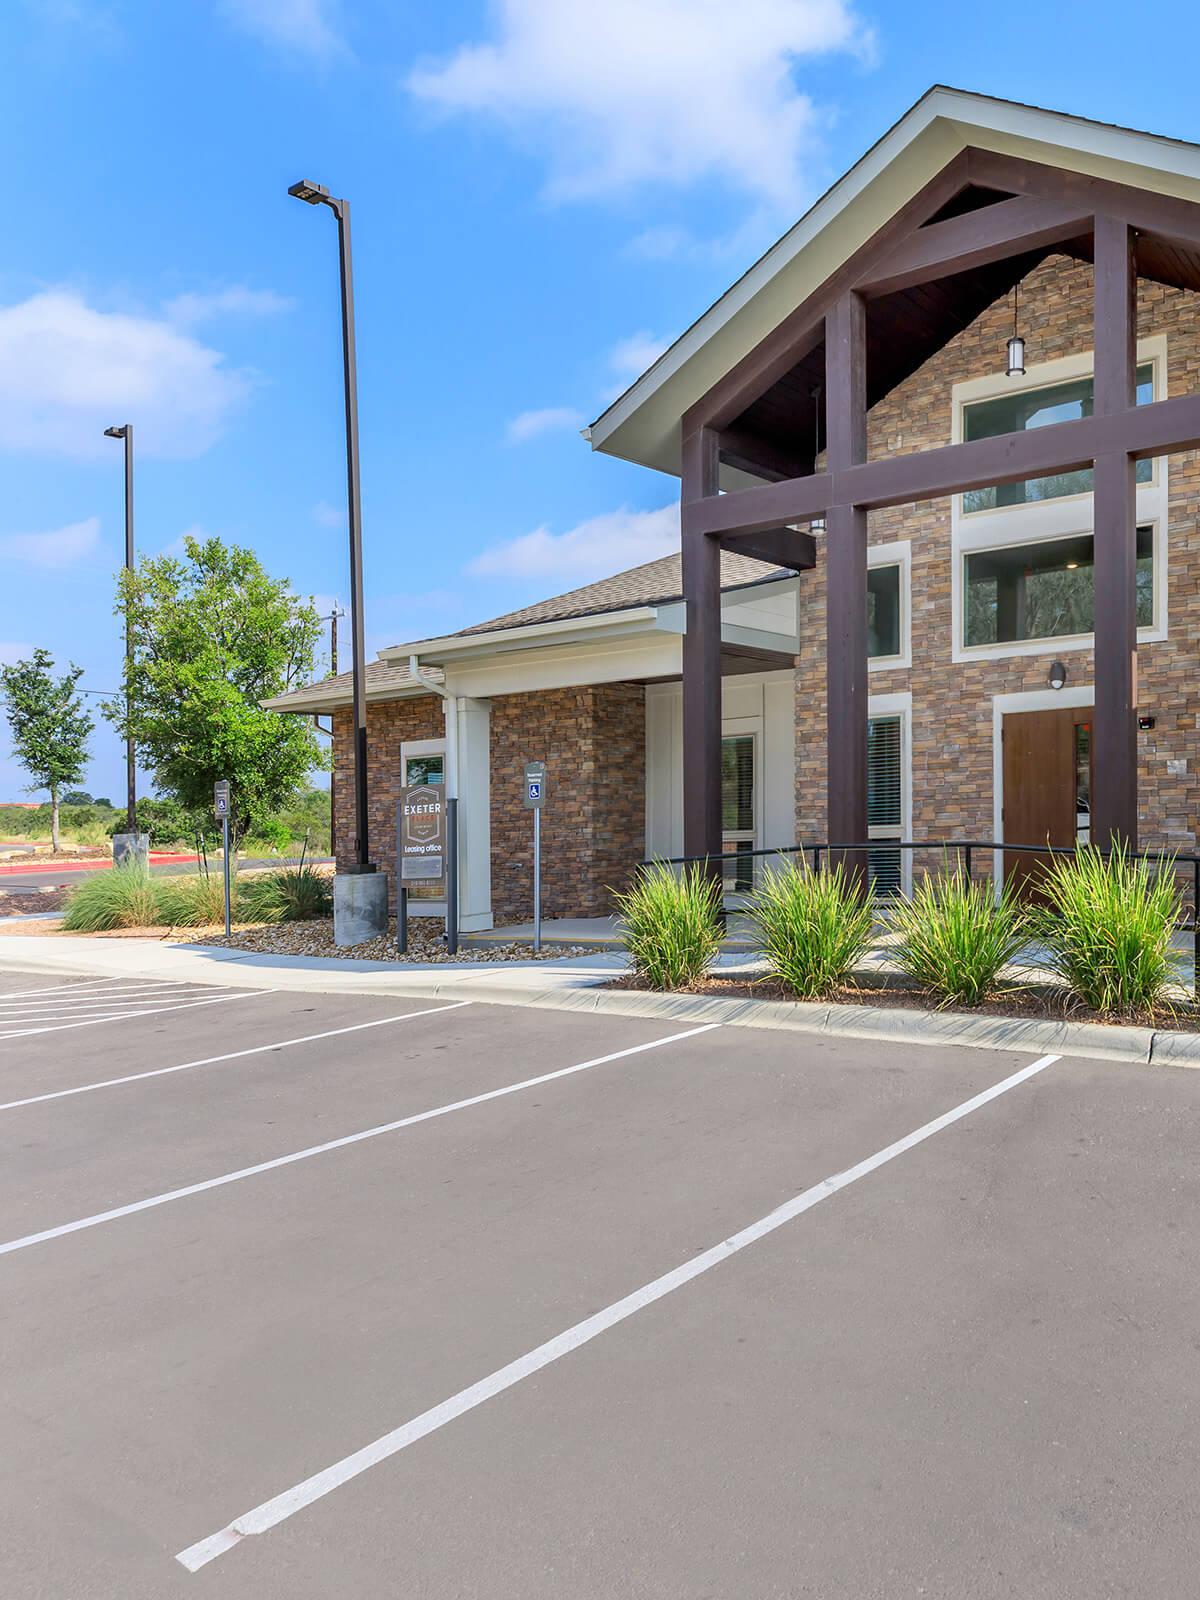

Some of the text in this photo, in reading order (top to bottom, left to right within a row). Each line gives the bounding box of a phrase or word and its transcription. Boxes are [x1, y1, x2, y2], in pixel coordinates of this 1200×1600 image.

[404, 802, 441, 816] EXETER
[404, 844, 442, 854] Leasing office
